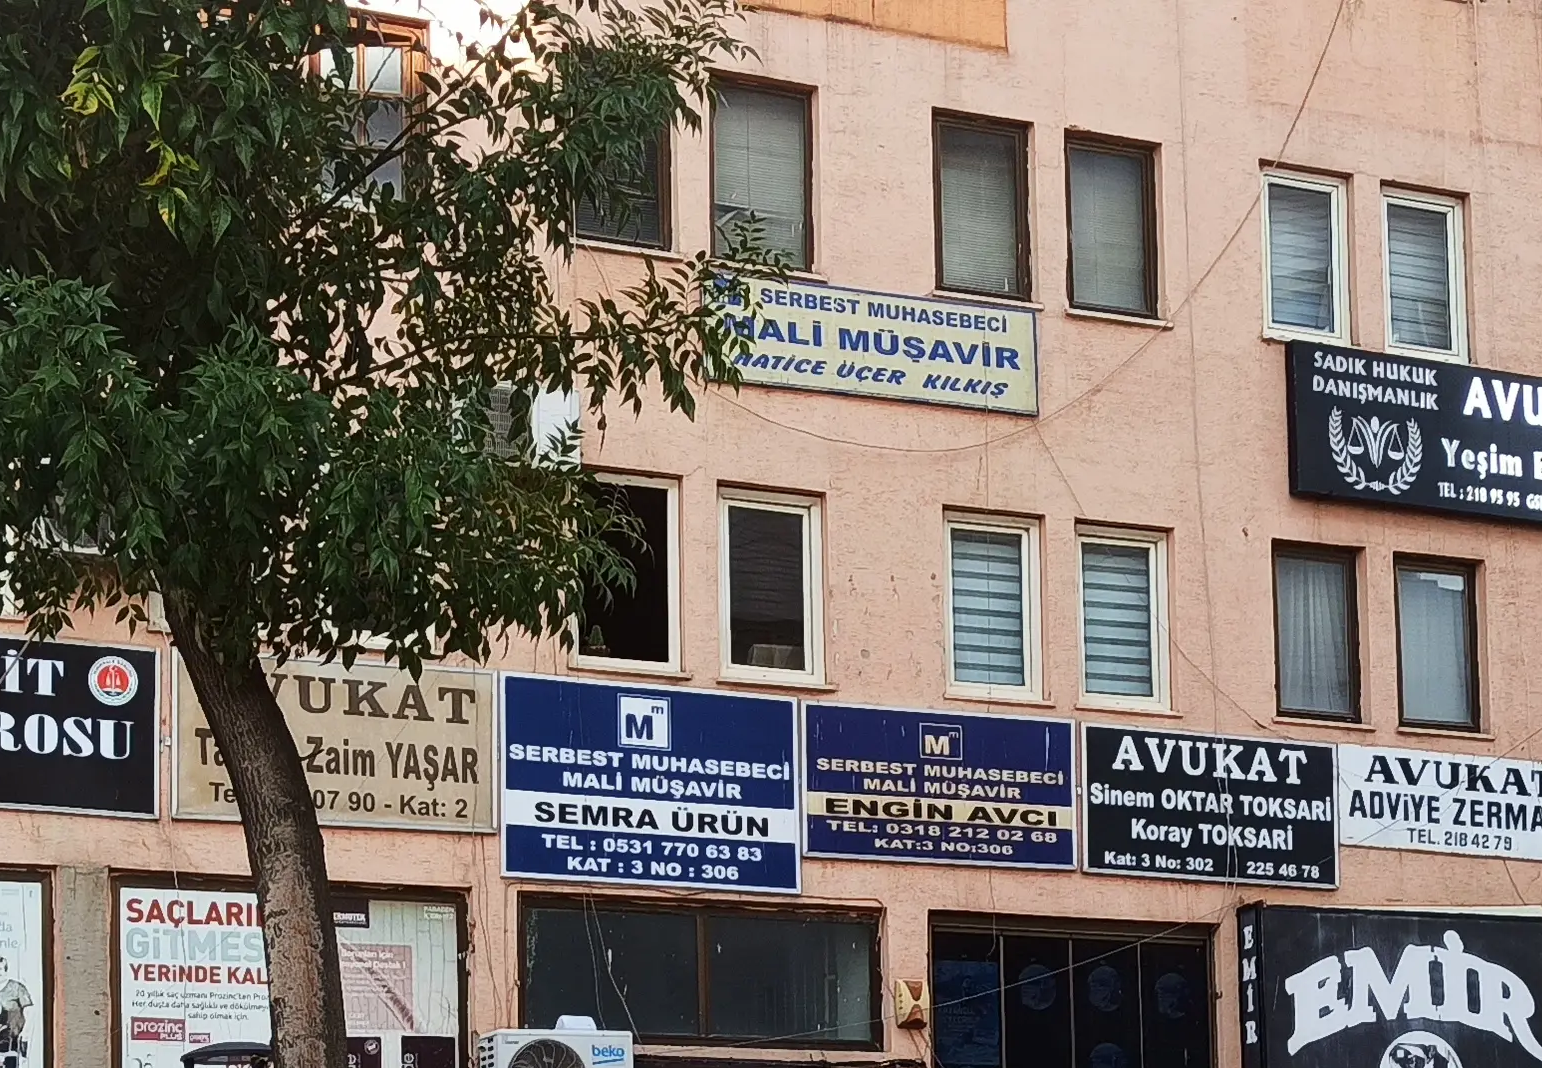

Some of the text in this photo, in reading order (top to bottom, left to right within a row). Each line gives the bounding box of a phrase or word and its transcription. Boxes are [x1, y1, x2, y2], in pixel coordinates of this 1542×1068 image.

[761, 288, 1007, 333] SERBEST MUHASEBECİ
[839, 327, 1021, 370] MÜŞAVİR
[836, 360, 907, 386] ÜÇER
[922, 374, 1009, 399] KILKIŞ
[1313, 351, 1438, 386] SADIK HUKUK
[1312, 375, 1439, 411] DANIŞMANLIK
[1441, 438, 1523, 479] Yeşim
[306, 736, 479, 791] Zaim YAŞAR
[509, 744, 790, 781] SERBEST MUHASEBECİ
[816, 758, 1064, 785] SERBEST MUHASEBECİ
[1112, 735, 1307, 785] AVUKAT
[562, 771, 742, 799] MALİ MÜŞAVİR
[864, 779, 1021, 799] MALİ MÜŞAVİR
[349, 792, 446, 818] 90 Kat:
[825, 798, 1057, 826] ENGİN AVCI
[1090, 783, 1332, 821] Sinem OKTAR TOKSARİ
[1349, 790, 1441, 825] ADVİYE
[534, 801, 769, 837] SEMRA ÜRÜN
[886, 823, 940, 836] 0318
[948, 827, 989, 839] 212
[997, 830, 1023, 841] 02
[1031, 832, 1057, 844] 68
[1131, 818, 1293, 850] Koray TOKSARİ
[603, 838, 762, 862] 0531 770 63 83
[1104, 851, 1319, 878] Kat: No: 302 225 46 78
[702, 865, 739, 880] 306
[130, 964, 222, 984] YERİNDE
[134, 1020, 183, 1034] prozinc
[592, 1045, 624, 1057] beko
